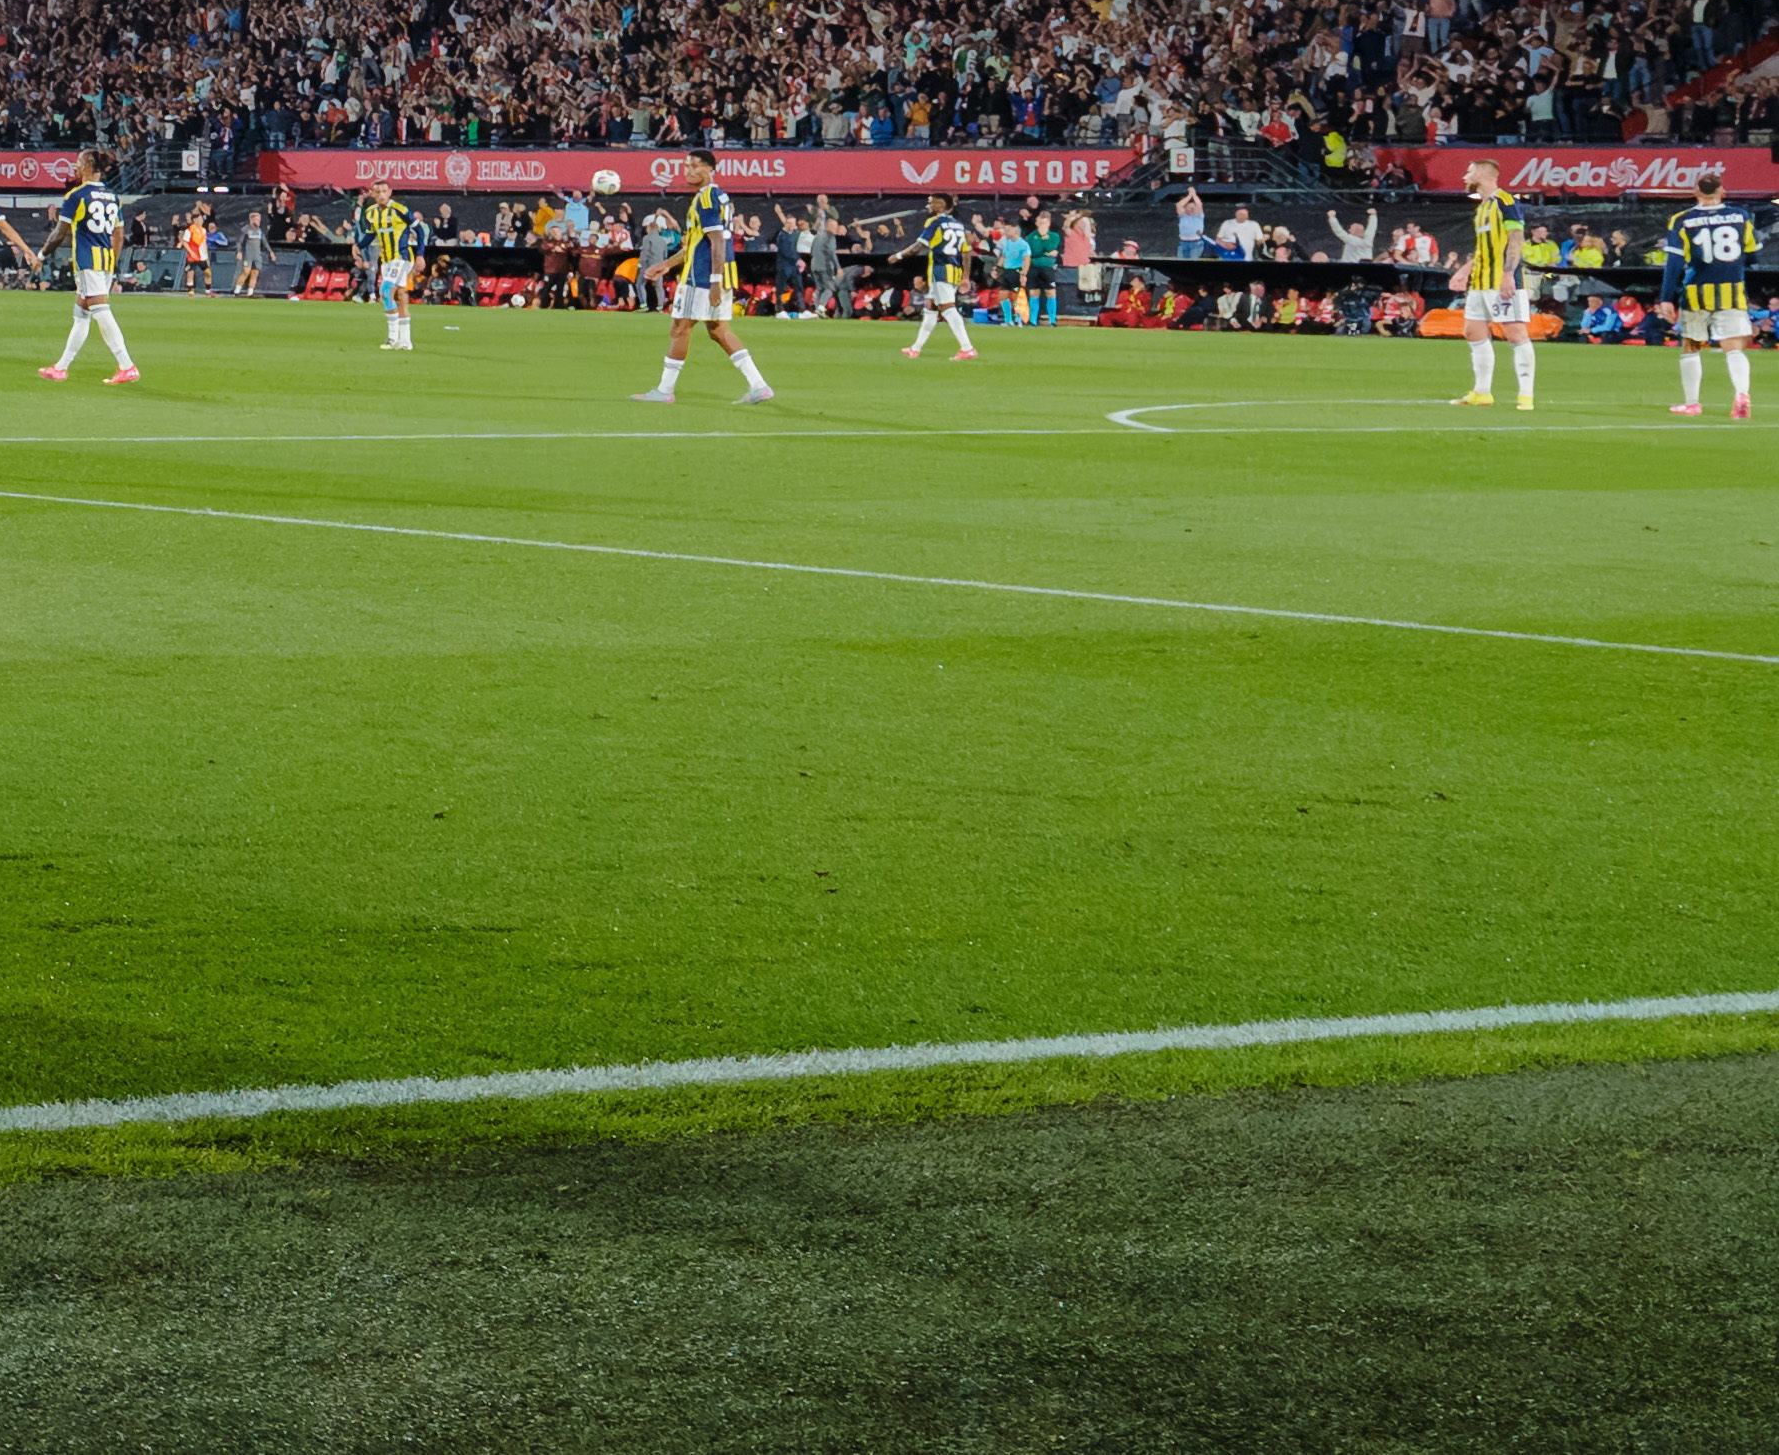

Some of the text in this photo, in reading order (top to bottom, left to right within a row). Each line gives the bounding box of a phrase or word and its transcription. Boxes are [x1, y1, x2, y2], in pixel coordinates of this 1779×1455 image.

[186, 154, 196, 167] C
[355, 159, 545, 181] DUTCH HEAD
[1175, 153, 1188, 168] B
[651, 157, 786, 187] QTMINALS
[86, 200, 119, 235] 33
[1692, 226, 1742, 264] 18
[1492, 302, 1512, 317] 37
